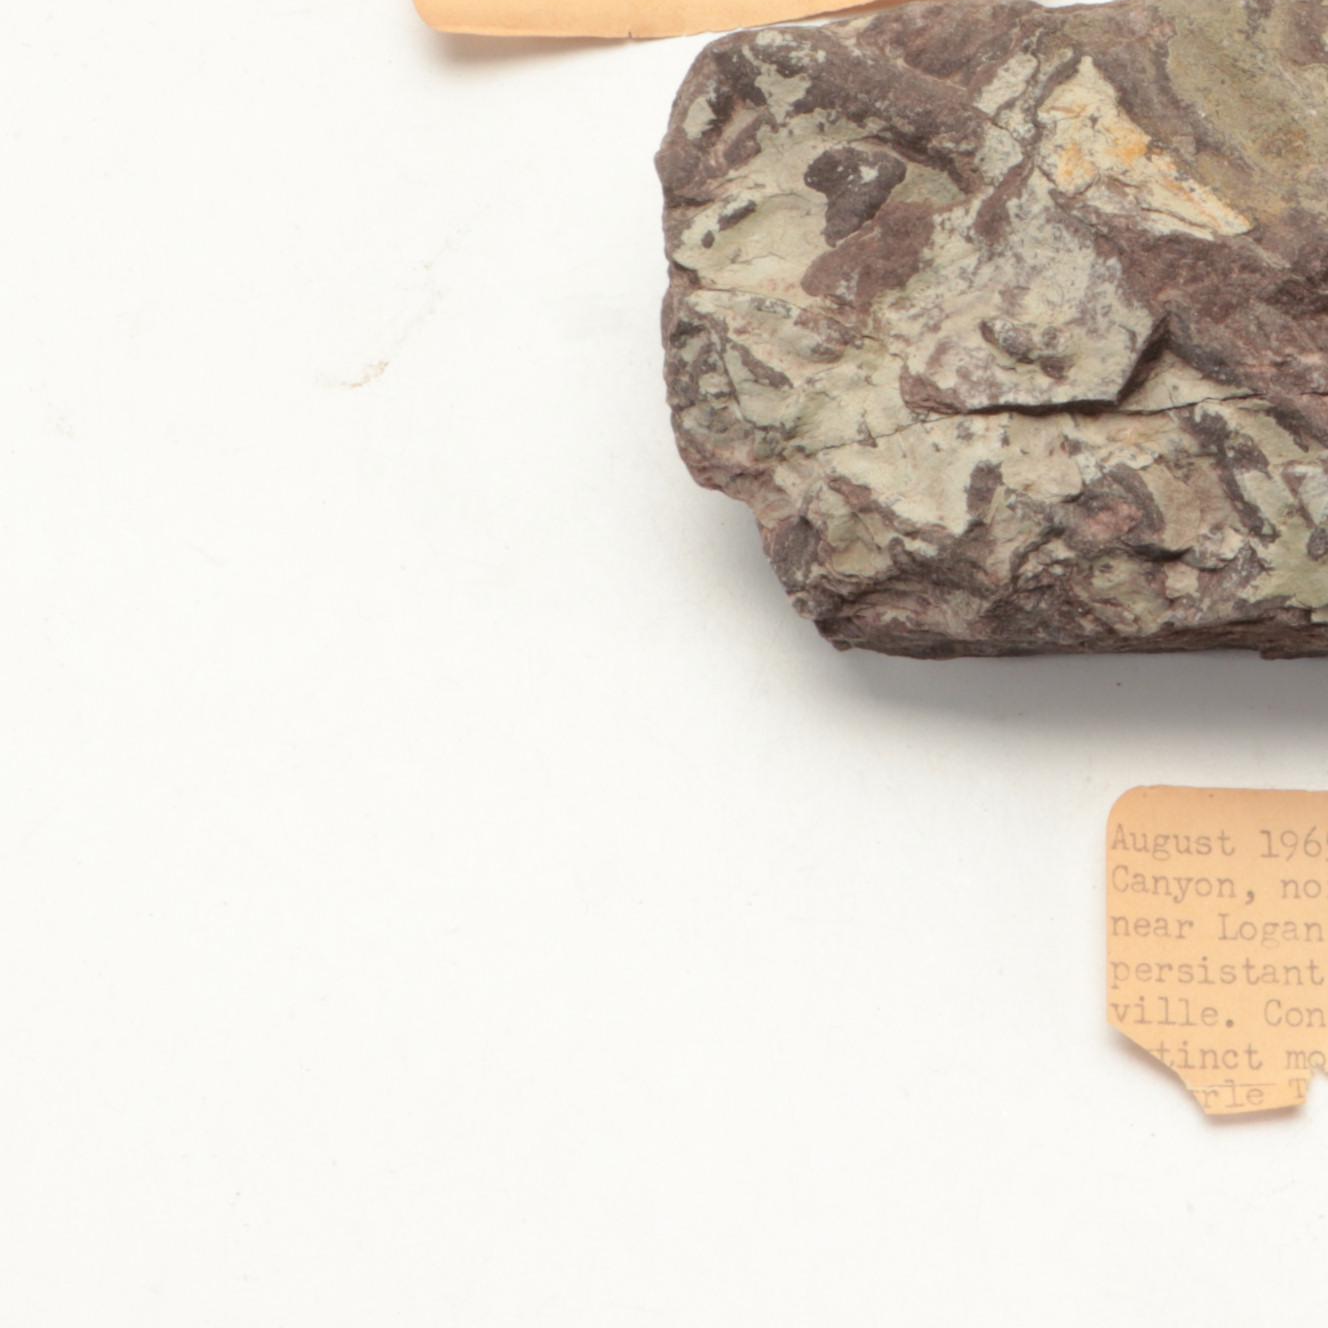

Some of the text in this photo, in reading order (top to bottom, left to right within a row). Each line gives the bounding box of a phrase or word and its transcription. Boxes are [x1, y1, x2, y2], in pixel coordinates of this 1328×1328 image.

[1110, 823, 1236, 861] August
[1111, 864, 1256, 906] Canyon,
[1110, 915, 1194, 940] near
[1110, 955, 1325, 990] persistant
[1109, 995, 1235, 1029] ville.
